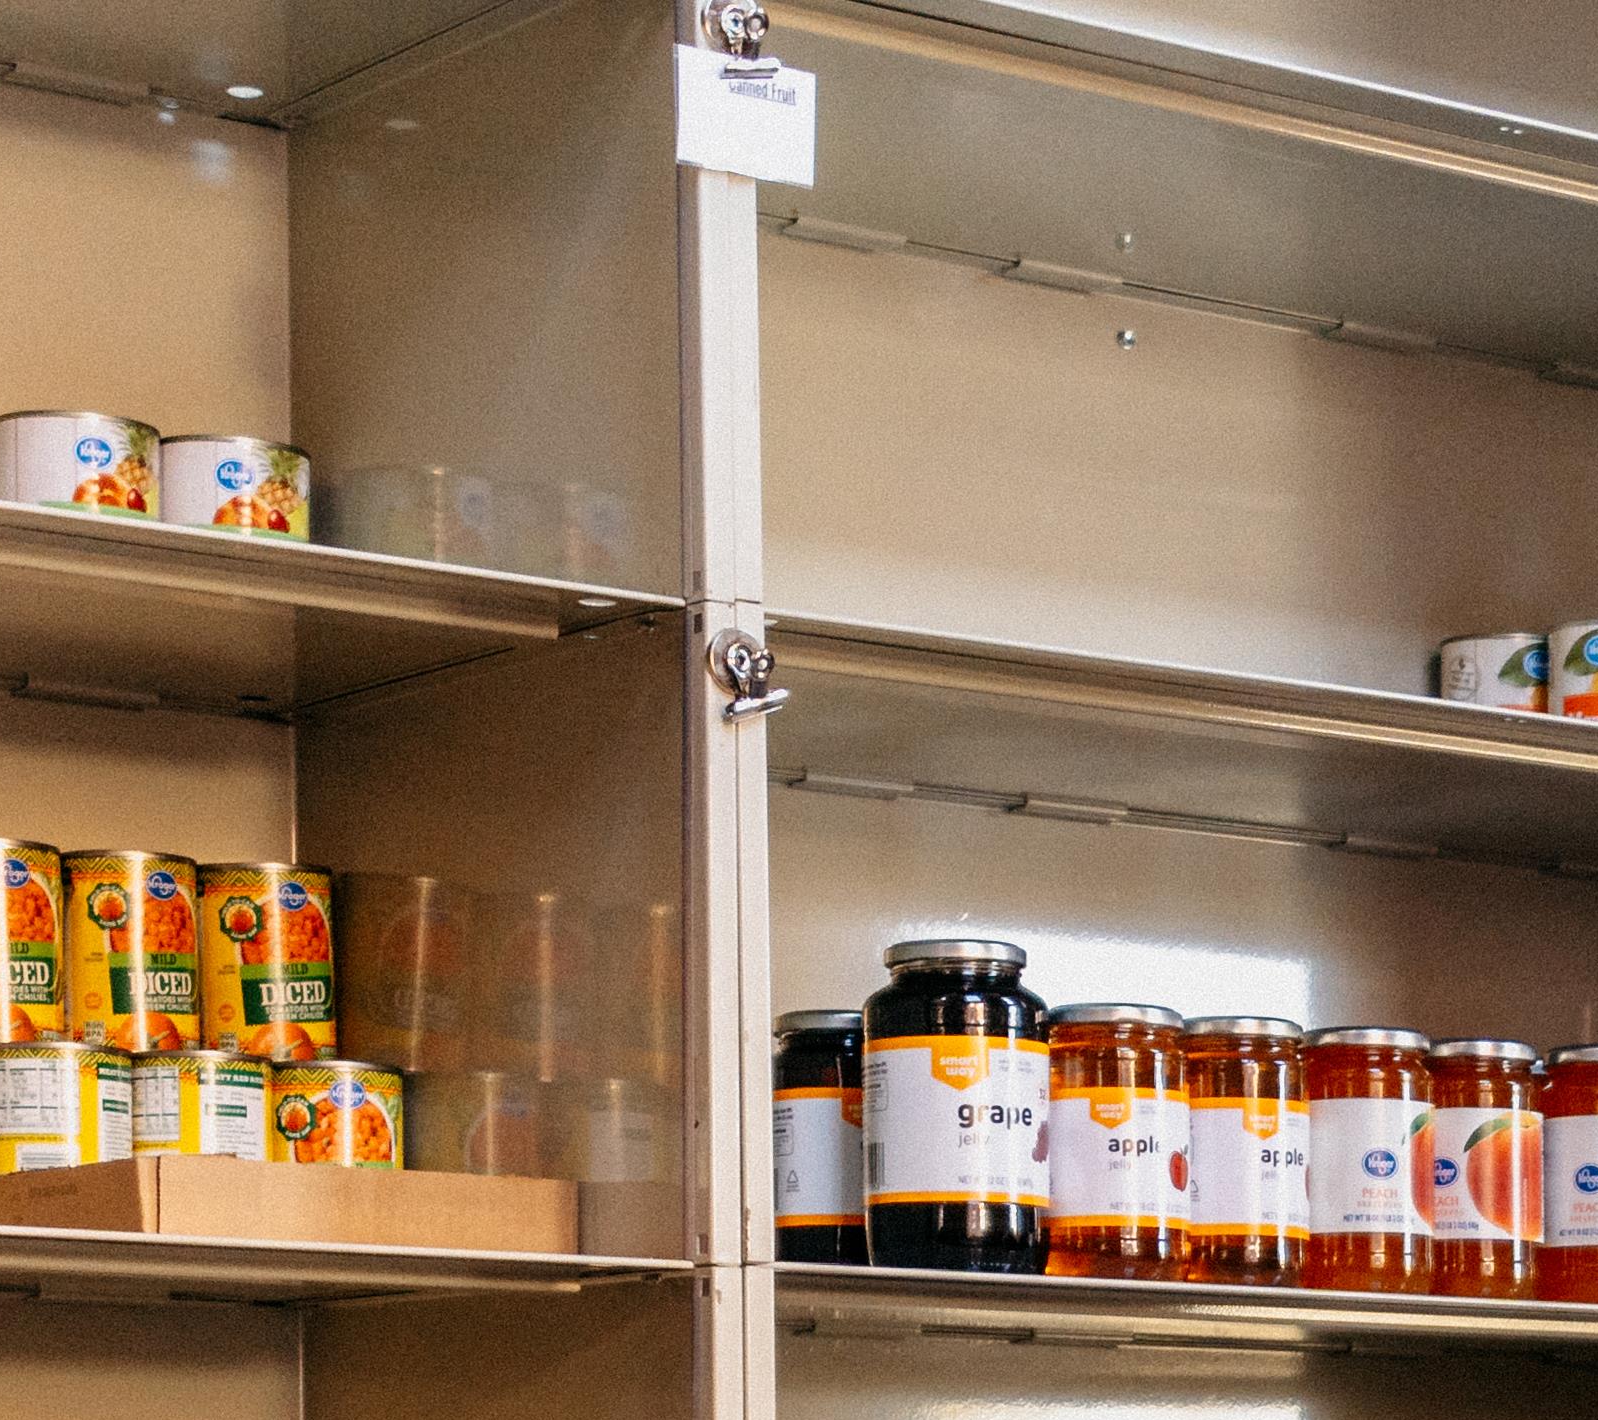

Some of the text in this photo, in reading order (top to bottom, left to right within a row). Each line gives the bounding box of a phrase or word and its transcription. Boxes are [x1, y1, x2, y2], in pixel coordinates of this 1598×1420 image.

[772, 84, 796, 104] Fruit
[129, 969, 192, 997] DICED
[260, 980, 325, 1008] DICED
[939, 1056, 979, 1068] smart
[946, 1067, 976, 1078] way
[959, 1100, 1032, 1127] grape
[1260, 1149, 1303, 1168] apple
[1362, 1188, 1398, 1198] PEACH
